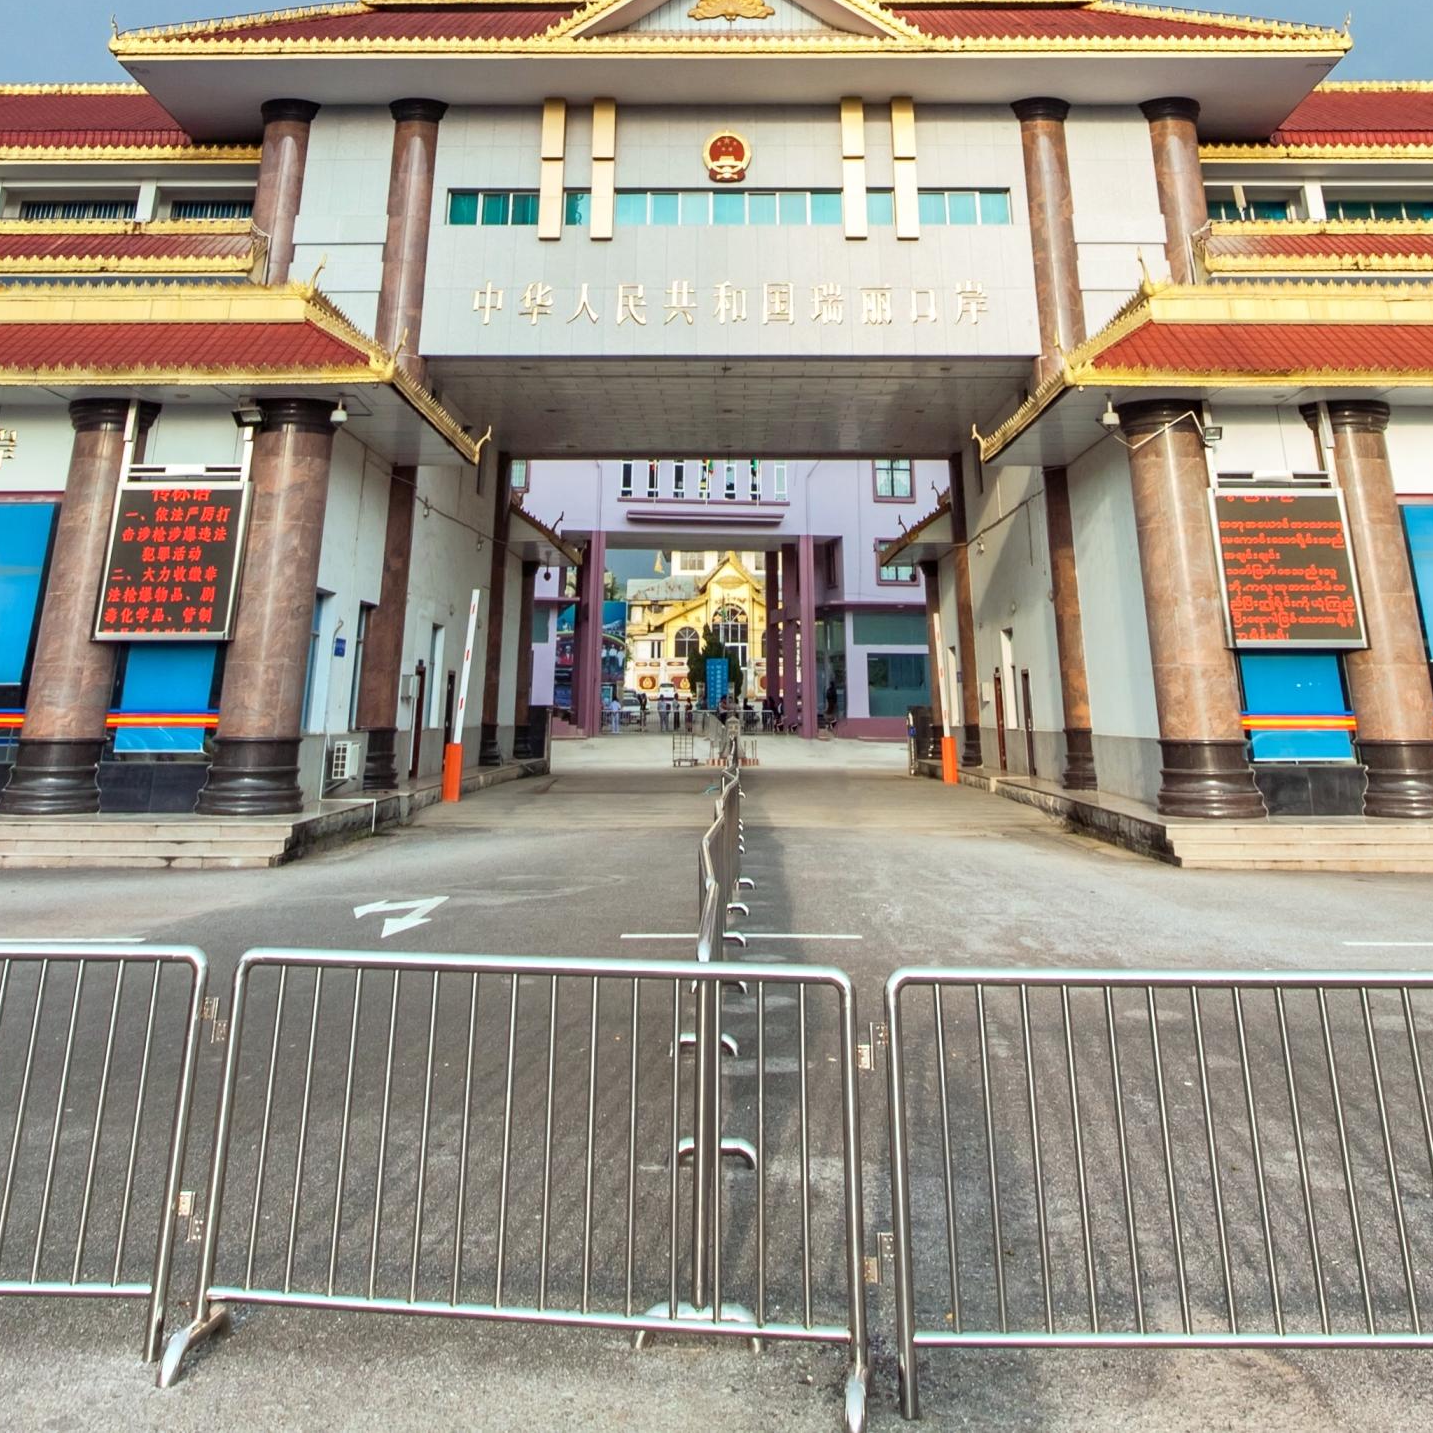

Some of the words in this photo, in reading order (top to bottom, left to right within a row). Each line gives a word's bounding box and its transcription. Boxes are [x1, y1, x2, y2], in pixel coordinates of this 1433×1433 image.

[471, 279, 990, 326] 中华人民共和国瑞丽口岸
[141, 546, 203, 562] 犯罪活动
